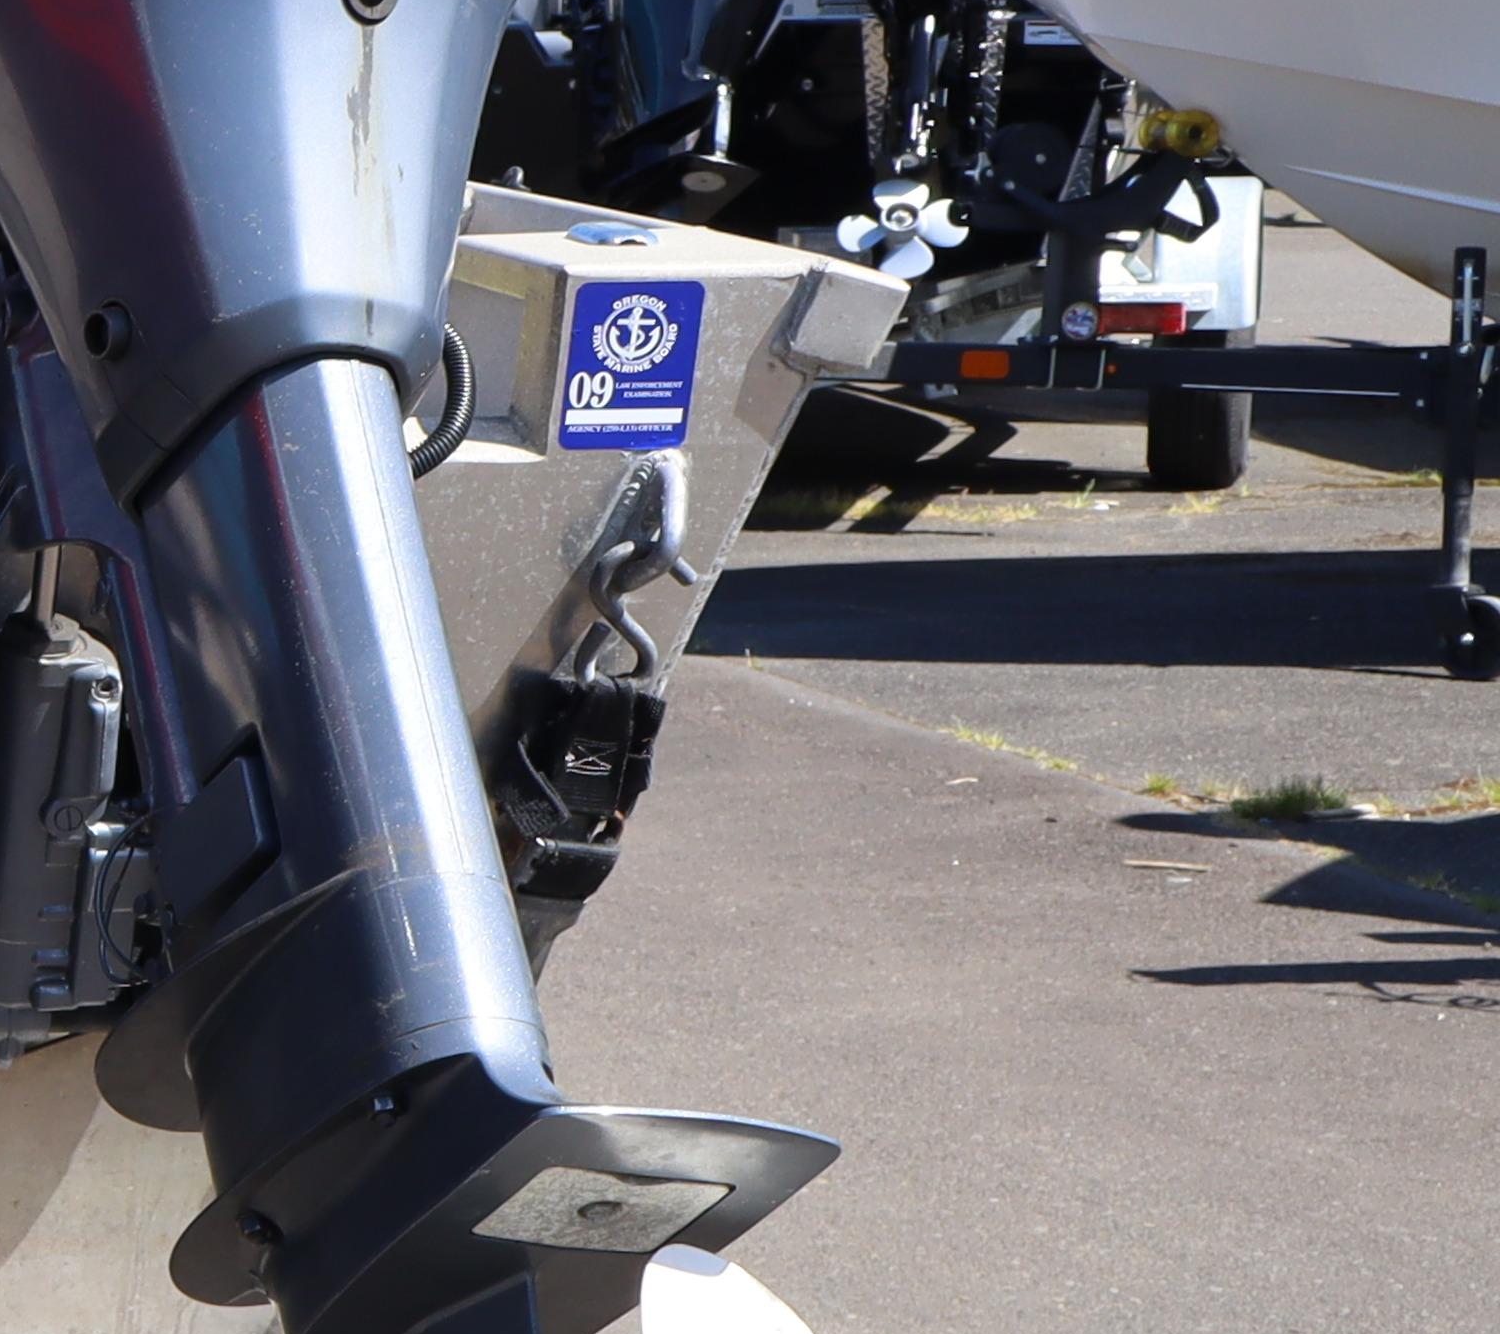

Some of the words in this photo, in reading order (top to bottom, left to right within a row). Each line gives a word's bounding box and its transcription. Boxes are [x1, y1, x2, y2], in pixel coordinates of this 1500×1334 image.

[613, 294, 668, 312] OREGON
[592, 324, 606, 361] STATE
[604, 356, 652, 374] MARINE
[654, 323, 679, 364] BOARD
[568, 371, 615, 409] 09
